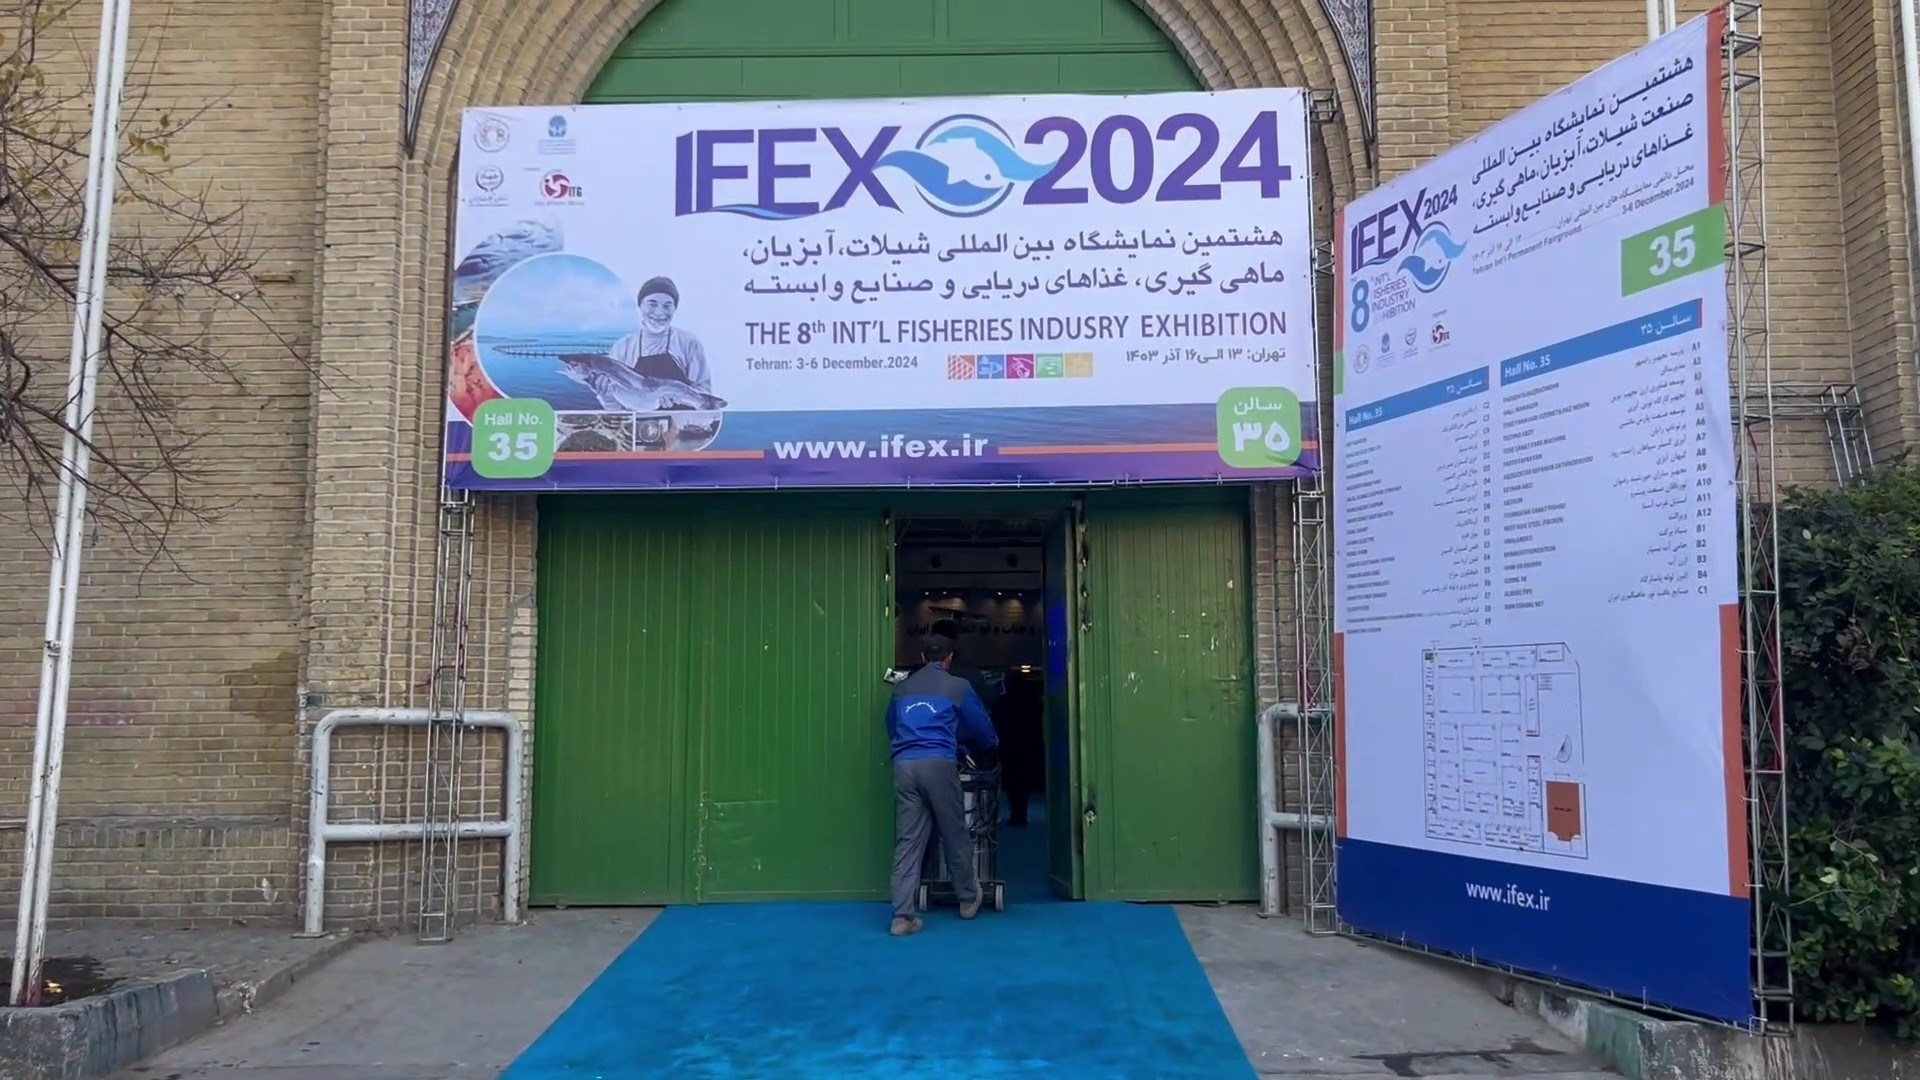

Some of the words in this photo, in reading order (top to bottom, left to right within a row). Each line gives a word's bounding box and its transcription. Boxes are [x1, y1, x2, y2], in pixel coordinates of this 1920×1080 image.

[1609, 57, 1694, 115] هشتمین
[1545, 98, 1605, 142] نمایشگاه
[1641, 92, 1694, 127] صنعت
[1508, 136, 1542, 166] بین
[1632, 122, 1694, 168] غذاهای
[675, 125, 904, 219] IFEX
[1023, 110, 1292, 206] 2024
[1472, 147, 1506, 185] المللی
[1577, 156, 1629, 195] دریایی
[1507, 166, 1536, 197] ماهی
[1521, 185, 1566, 221] صنایع
[1063, 228, 1176, 259] نمایشگاه
[1182, 226, 1283, 256] هشتمین
[1351, 187, 1427, 275] IFEX
[1423, 184, 1458, 220] 2024
[1508, 241, 1543, 260] Permanent
[1544, 224, 1582, 246] Fairground
[937, 232, 1008, 263] المللی
[1013, 235, 1054, 261] بین
[1649, 225, 1697, 277] 35
[743, 272, 845, 302] وابسته
[850, 271, 934, 304] صنایع
[940, 279, 956, 299] و
[962, 270, 1040, 300] دریایی
[1045, 266, 1128, 295] غذاهای
[1135, 262, 1213, 296] گیری،
[1219, 261, 1285, 294] ماهی
[1350, 279, 1370, 333] 8
[1371, 288, 1410, 313] INDUSTRY
[745, 321, 791, 345] THE
[797, 319, 826, 345] 8th
[832, 319, 891, 344] INT'L
[898, 317, 1014, 343] FISHERIES
[1019, 315, 1129, 341] INDUSRY
[1141, 311, 1287, 338] EXHIBITION
[1656, 315, 1692, 335] سالن
[745, 357, 793, 371] Tehran:
[796, 356, 819, 370] 3-6
[822, 355, 919, 370] December.2024
[1126, 348, 1159, 362] ۱۴۰۳
[1162, 347, 1181, 364] آذر
[1227, 347, 1243, 360] ۱۳
[1246, 347, 1286, 363] تهران:
[1504, 360, 1522, 378] Hall
[1523, 358, 1538, 374] No.
[1539, 354, 1551, 368] 35
[484, 411, 513, 427] Hall
[518, 411, 543, 427] No.
[1234, 396, 1282, 416] سالن
[1696, 417, 1705, 426] A6
[487, 431, 539, 462] 35
[774, 433, 988, 460] www.ifex.ir
[1232, 420, 1290, 453] ۳۵
[1696, 432, 1706, 442] A7
[1696, 448, 1707, 457] A8
[1696, 463, 1707, 472] A9
[1696, 477, 1712, 487] A10
[1696, 493, 1711, 502] A11
[1696, 508, 1712, 518] A12
[1696, 524, 1706, 533] B1
[1696, 539, 1706, 548] B2
[1697, 555, 1706, 563] B3
[1697, 570, 1708, 579] B4
[1697, 585, 1708, 594] C1
[1466, 881, 1551, 911] www.ifex.ir
